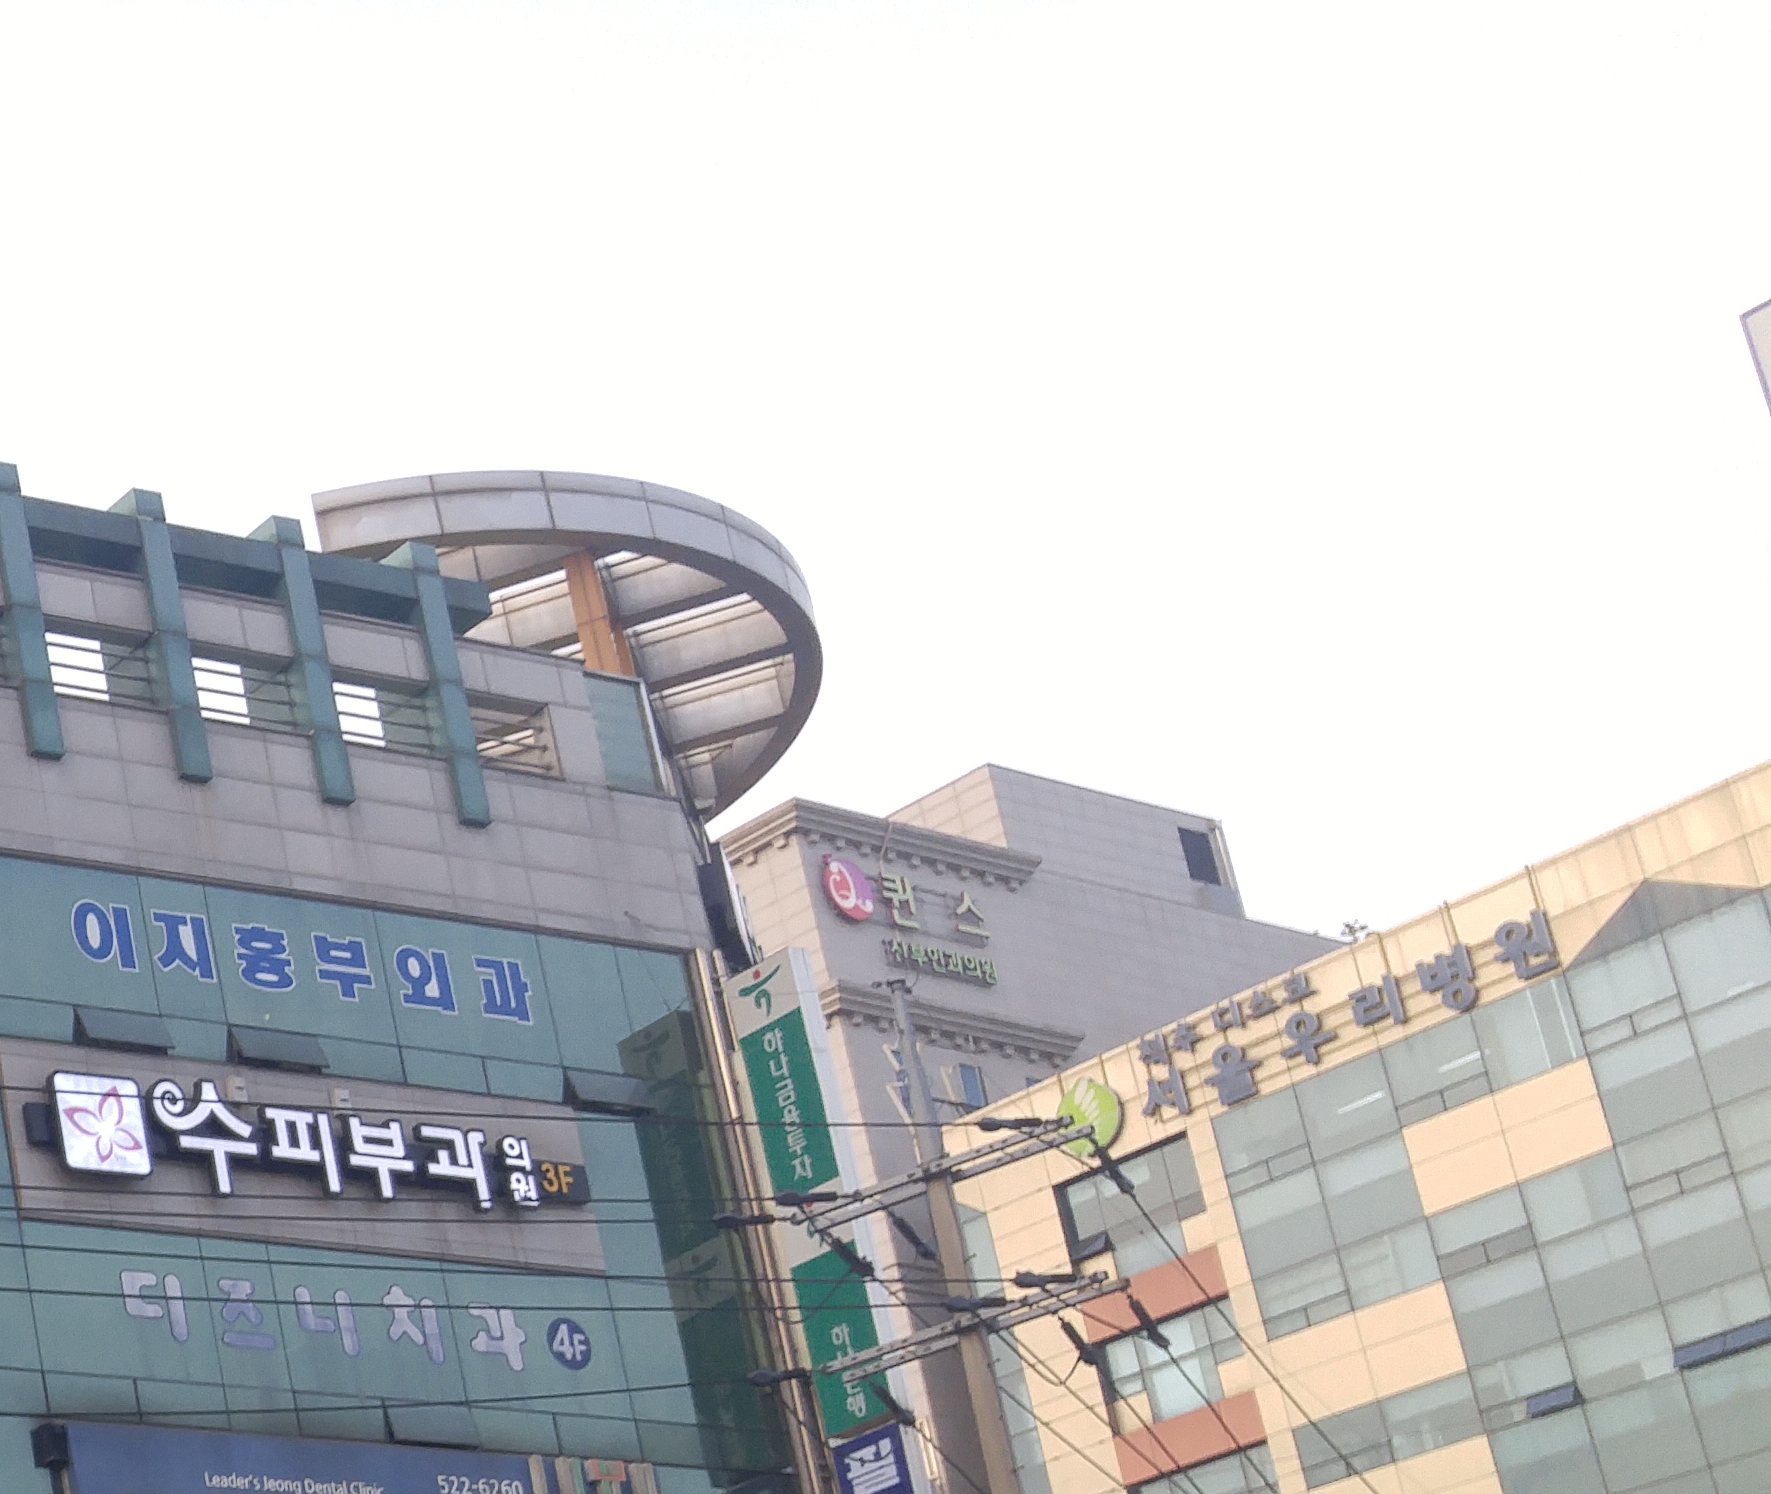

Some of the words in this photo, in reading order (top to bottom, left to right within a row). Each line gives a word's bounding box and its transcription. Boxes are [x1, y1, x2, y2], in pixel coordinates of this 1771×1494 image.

[71, 898, 534, 1026] 이지흉부외과
[1143, 909, 1558, 1117] 서울우리병원
[541, 1161, 575, 1194] 3F
[119, 1269, 526, 1373] 디즈니치과
[550, 1321, 589, 1363] 4F
[204, 1472, 261, 1493] Leader's
